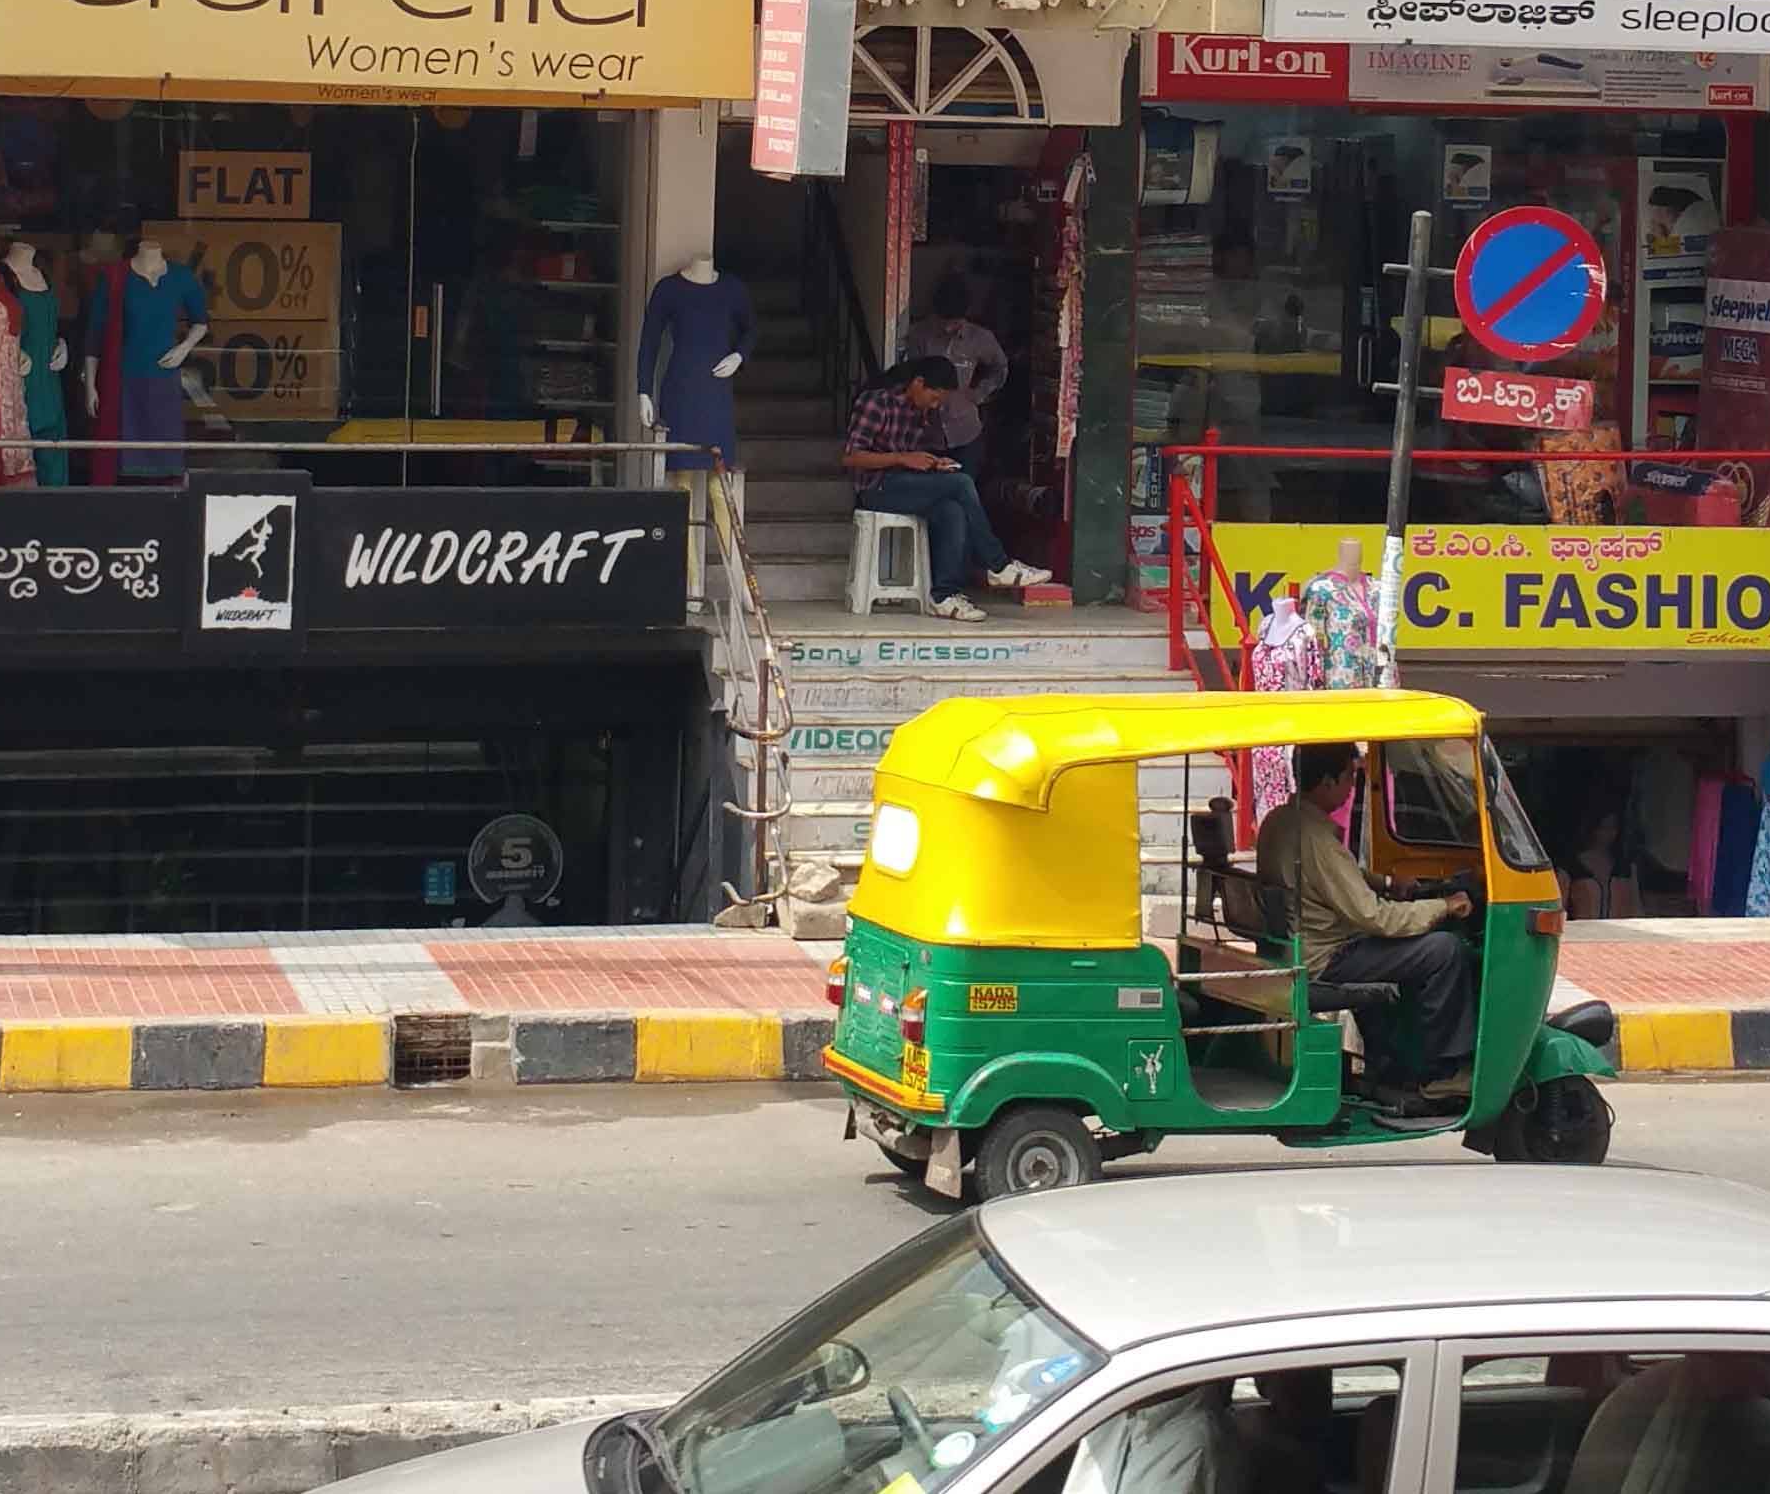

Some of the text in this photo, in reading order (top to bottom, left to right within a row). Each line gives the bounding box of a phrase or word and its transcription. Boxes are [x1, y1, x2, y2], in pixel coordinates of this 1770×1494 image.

[306, 34, 645, 82] Women's wear
[1170, 33, 1332, 79] Kurl-on
[1367, 50, 1471, 73] IMAGINE
[188, 166, 303, 205] FLAT
[344, 526, 646, 590] WILDCRAFT
[215, 608, 276, 623] WILDCRAFT
[790, 642, 1010, 665] Sony Ericsson
